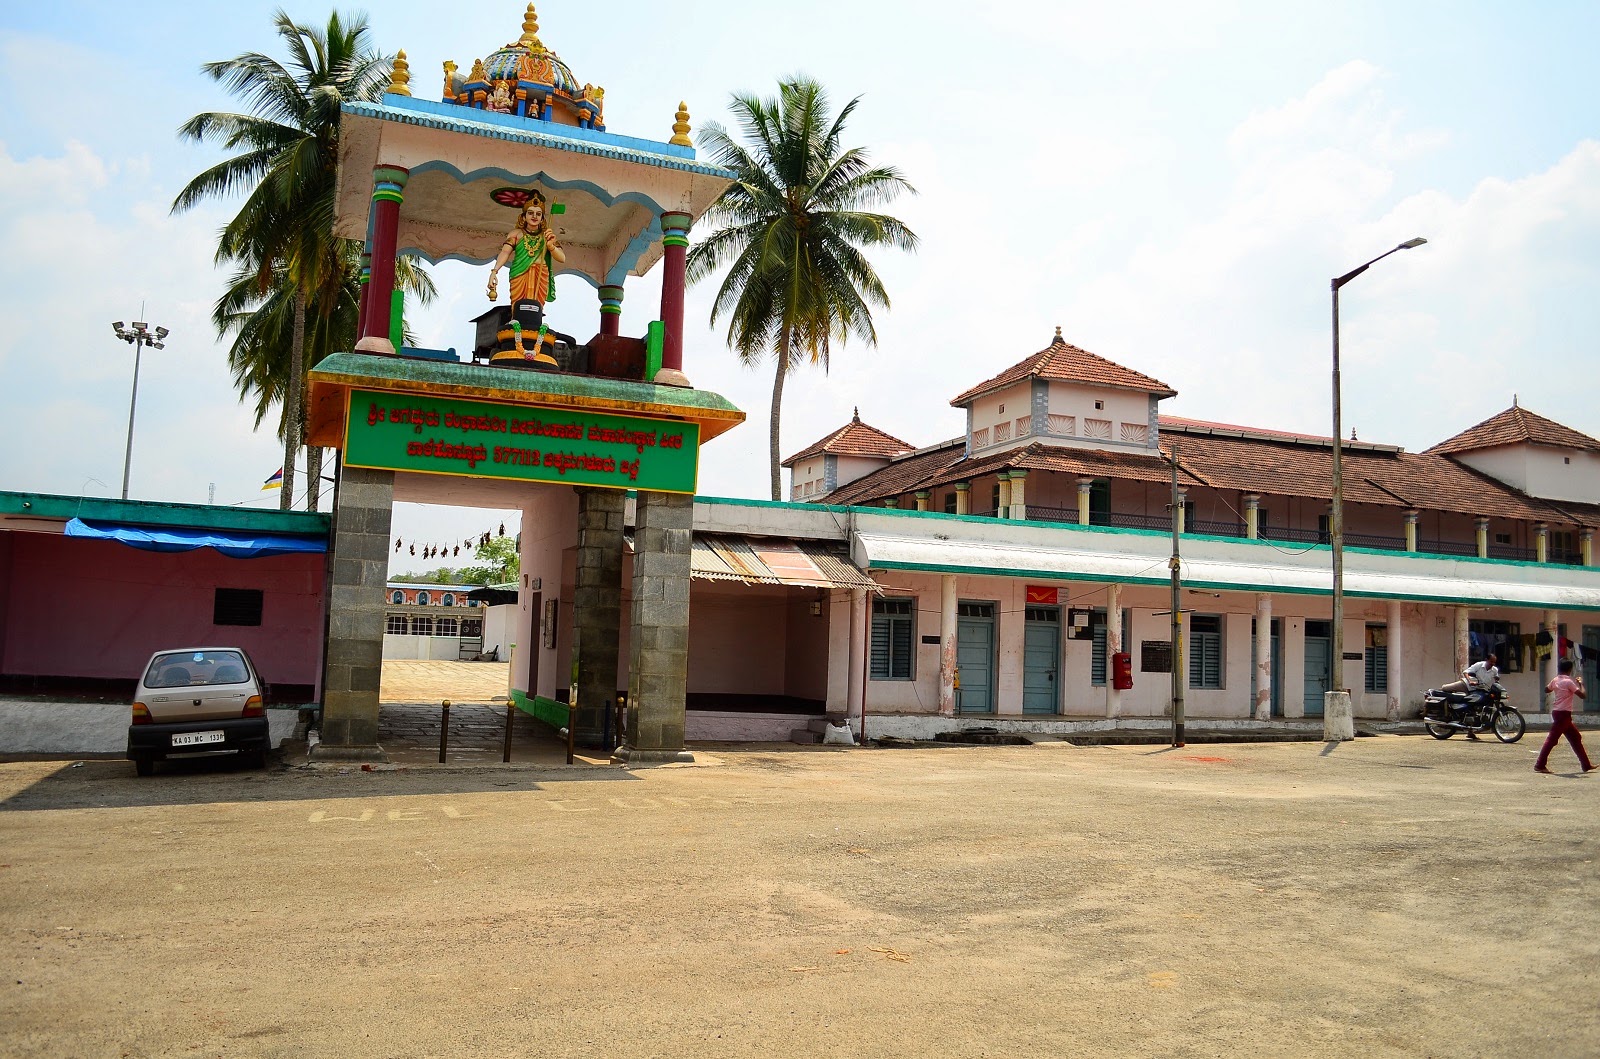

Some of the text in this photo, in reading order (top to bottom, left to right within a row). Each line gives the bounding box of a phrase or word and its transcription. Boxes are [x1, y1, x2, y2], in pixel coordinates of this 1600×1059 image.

[367, 403, 386, 426] ಶ್ರೀ
[389, 407, 440, 434] ಜಗದ್ಗುರು
[493, 445, 541, 467] 577112
